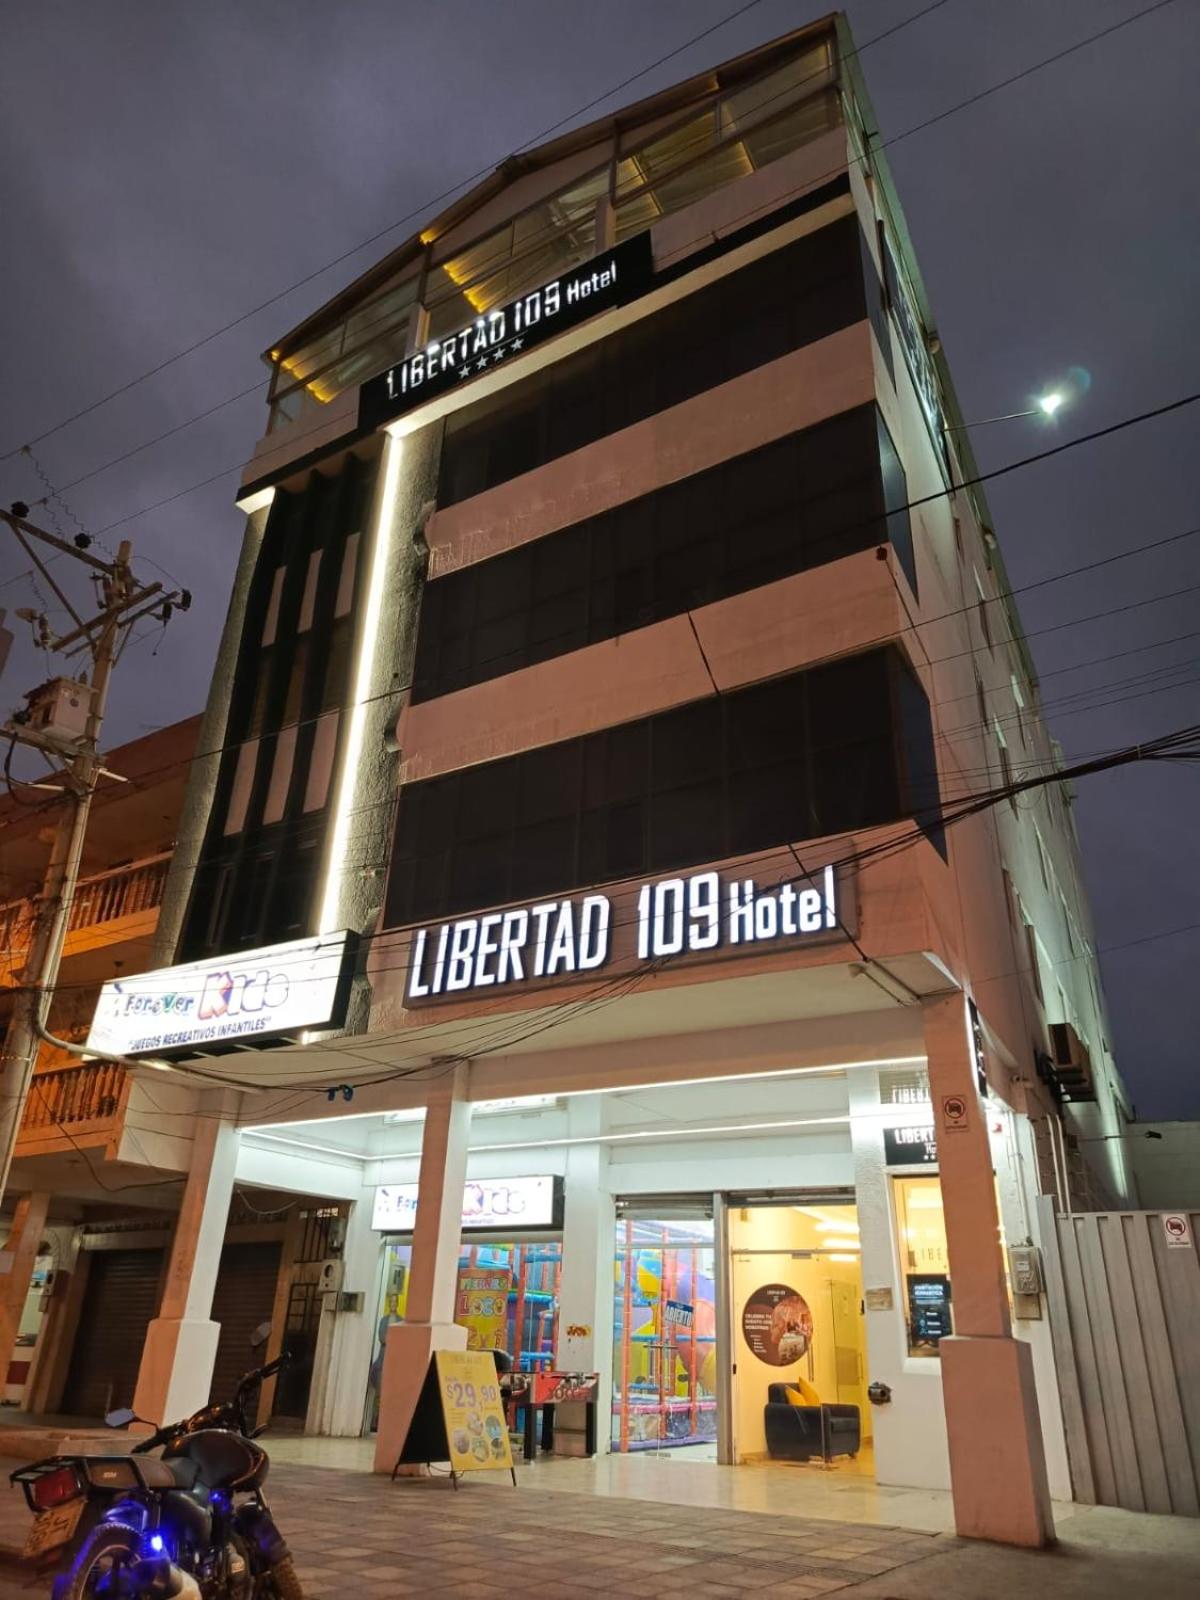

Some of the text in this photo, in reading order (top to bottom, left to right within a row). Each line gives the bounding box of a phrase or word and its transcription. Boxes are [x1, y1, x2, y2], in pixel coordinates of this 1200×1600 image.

[387, 259, 617, 400] LIBERTAD 109 Hotel
[408, 864, 837, 997] LIBERTAD 109 Hotel
[162, 1027, 216, 1044] RECREATIVOS
[894, 1127, 935, 1144] LIBERT
